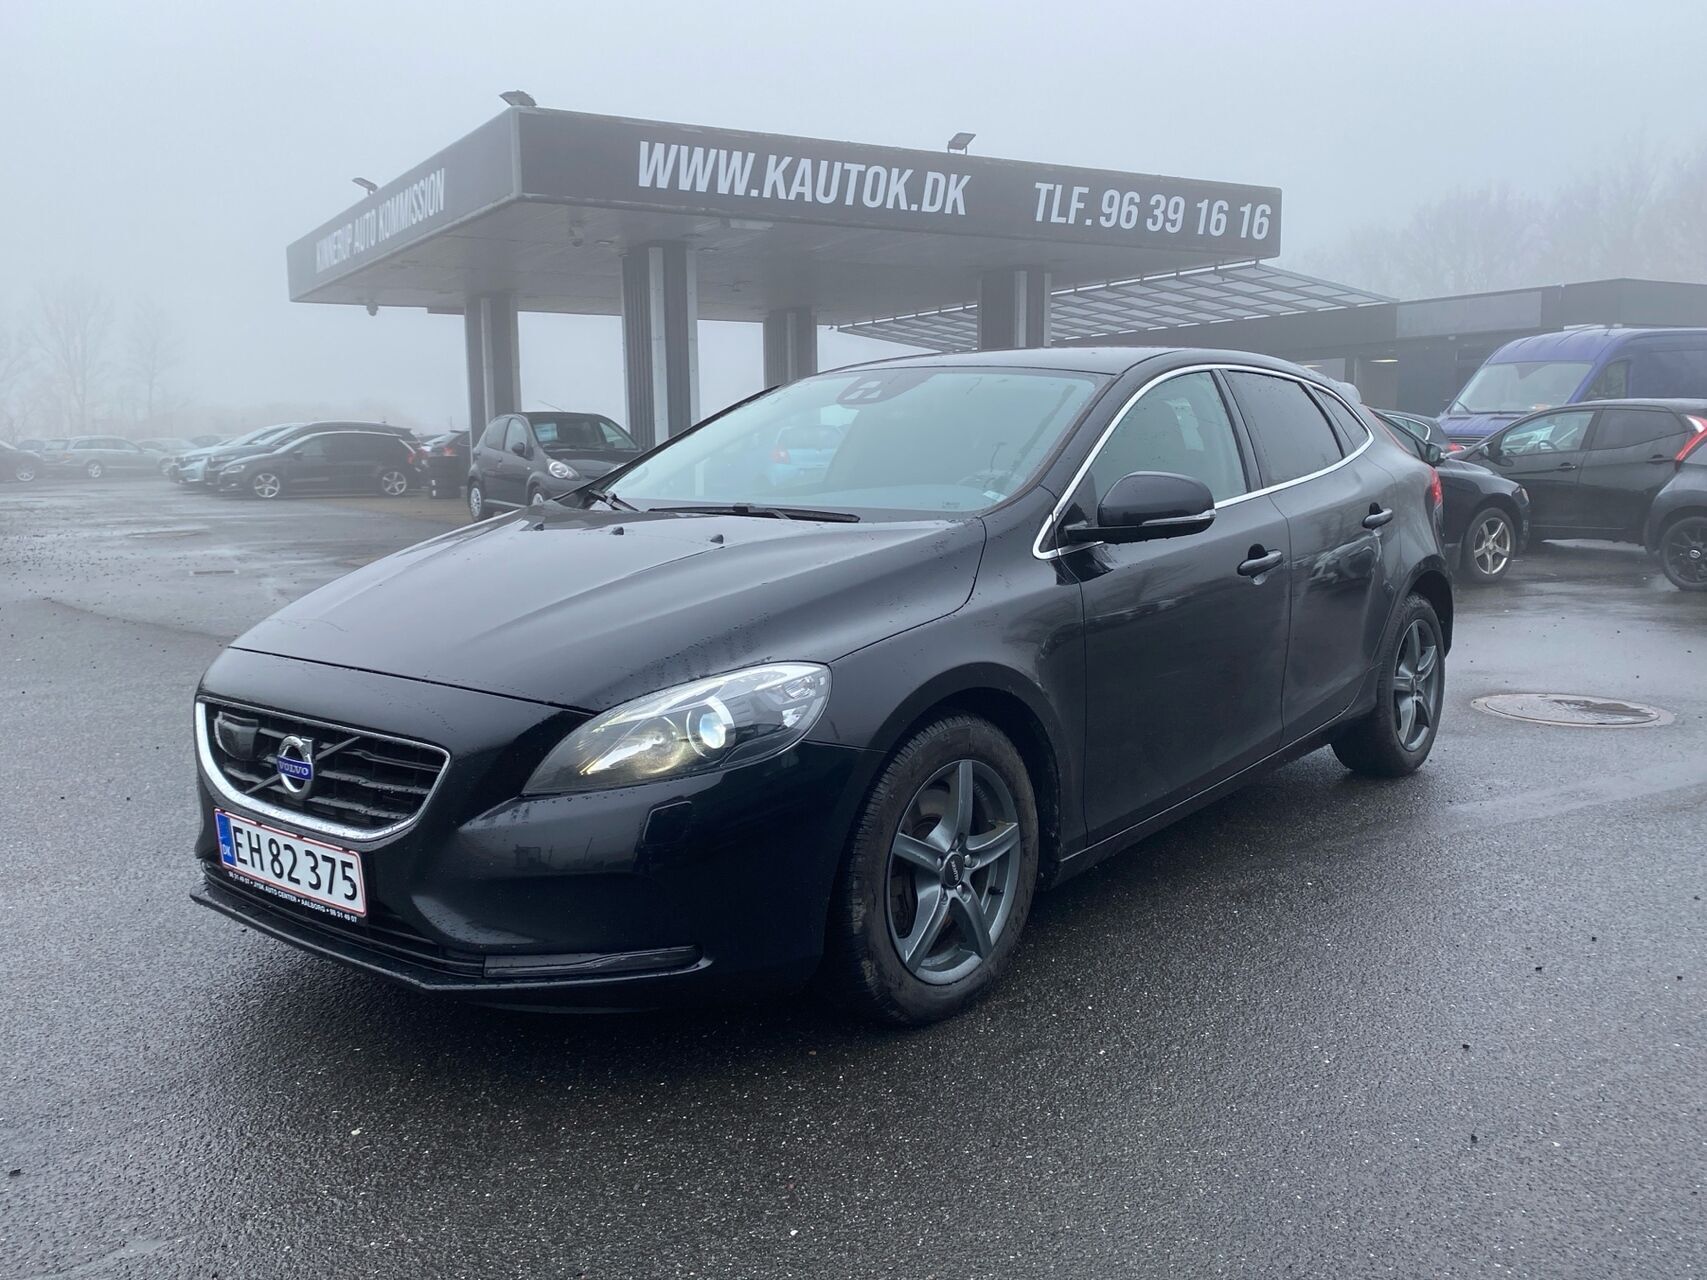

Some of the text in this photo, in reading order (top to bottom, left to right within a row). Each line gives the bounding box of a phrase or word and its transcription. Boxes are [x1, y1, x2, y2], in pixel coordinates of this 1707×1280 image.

[353, 208, 376, 255] AUTO
[378, 167, 446, 243] KOMMISSION
[638, 140, 972, 216] WWW.KAUTOK.DK
[1034, 181, 1272, 241] TLF. 96 39 16 16
[278, 760, 309, 776] VOLVO
[232, 825, 358, 902] EH 82 375
